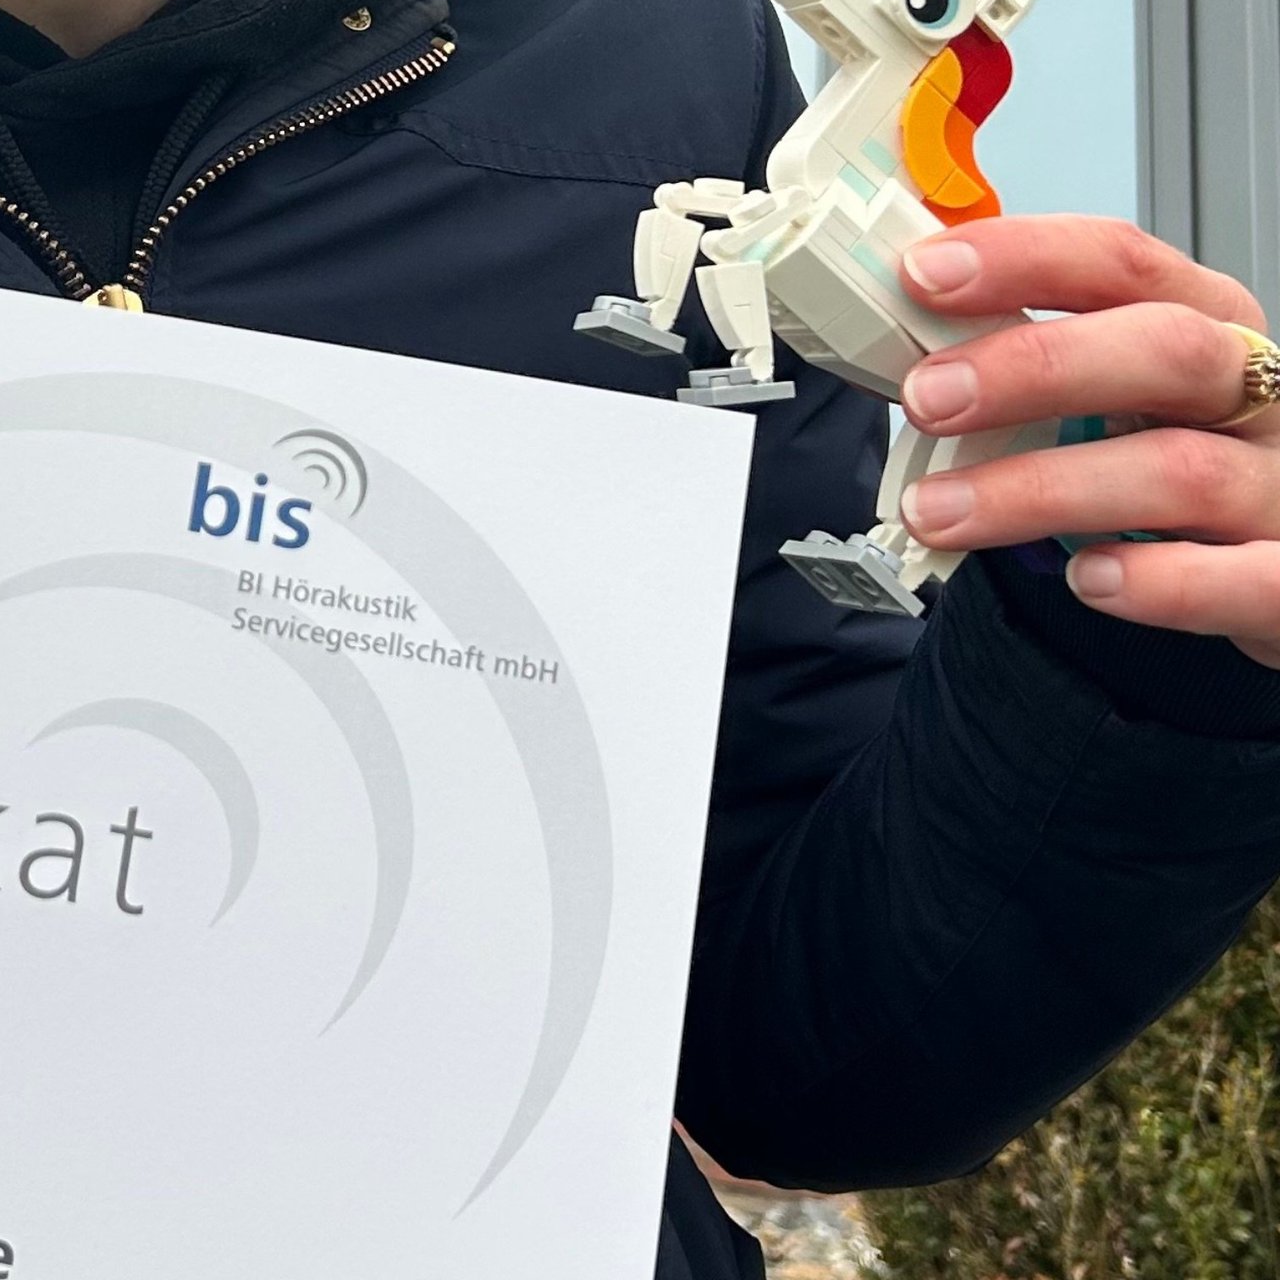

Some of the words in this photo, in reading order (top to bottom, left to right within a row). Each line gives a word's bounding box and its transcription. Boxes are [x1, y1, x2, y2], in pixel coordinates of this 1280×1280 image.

[187, 461, 312, 549] bis
[237, 570, 263, 596] BI
[271, 576, 419, 622] Hörakustik
[231, 607, 485, 672] Servicegesellschaft
[493, 654, 559, 685] mbH
